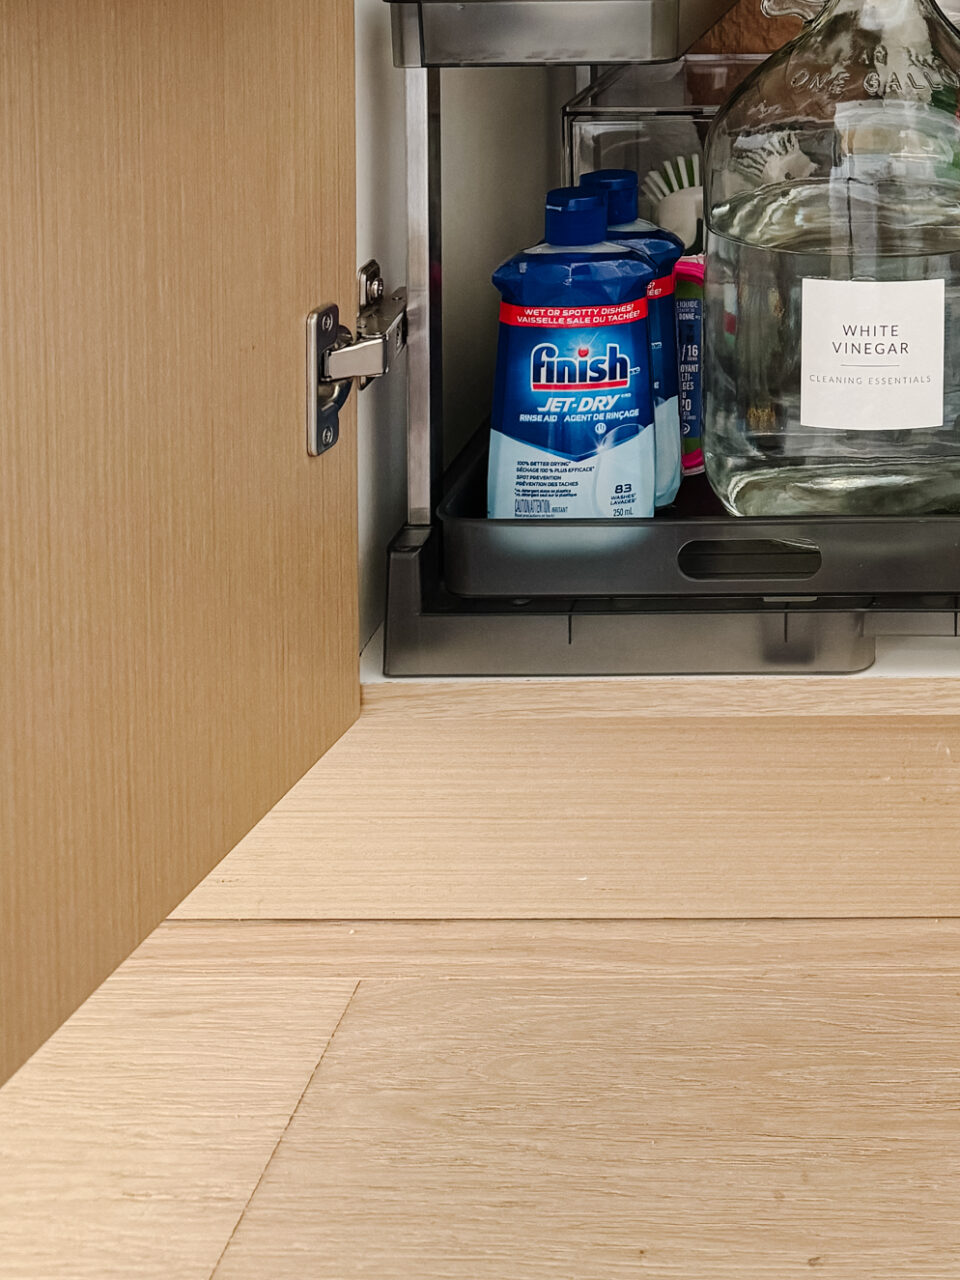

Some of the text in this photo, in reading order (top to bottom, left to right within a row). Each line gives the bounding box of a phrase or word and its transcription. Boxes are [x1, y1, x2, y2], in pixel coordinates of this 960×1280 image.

[790, 69, 851, 95] ONE
[524, 308, 546, 316] WET
[562, 308, 600, 316] SPOTTY
[516, 316, 565, 324] VAISSELLE
[566, 316, 591, 324] SALE
[592, 316, 607, 324] OU
[842, 324, 900, 337] WHITE
[831, 341, 910, 355] VINEGAR
[530, 342, 631, 385] finish
[680, 364, 699, 373] OYANT
[809, 374, 932, 385] CLEANING ESSENTIALS
[537, 394, 621, 412] JET-DRY
[519, 408, 640, 422] RINSE AID AGENT DE RINÇAGE
[614, 483, 632, 494] 83
[612, 507, 634, 517] 250 mL
